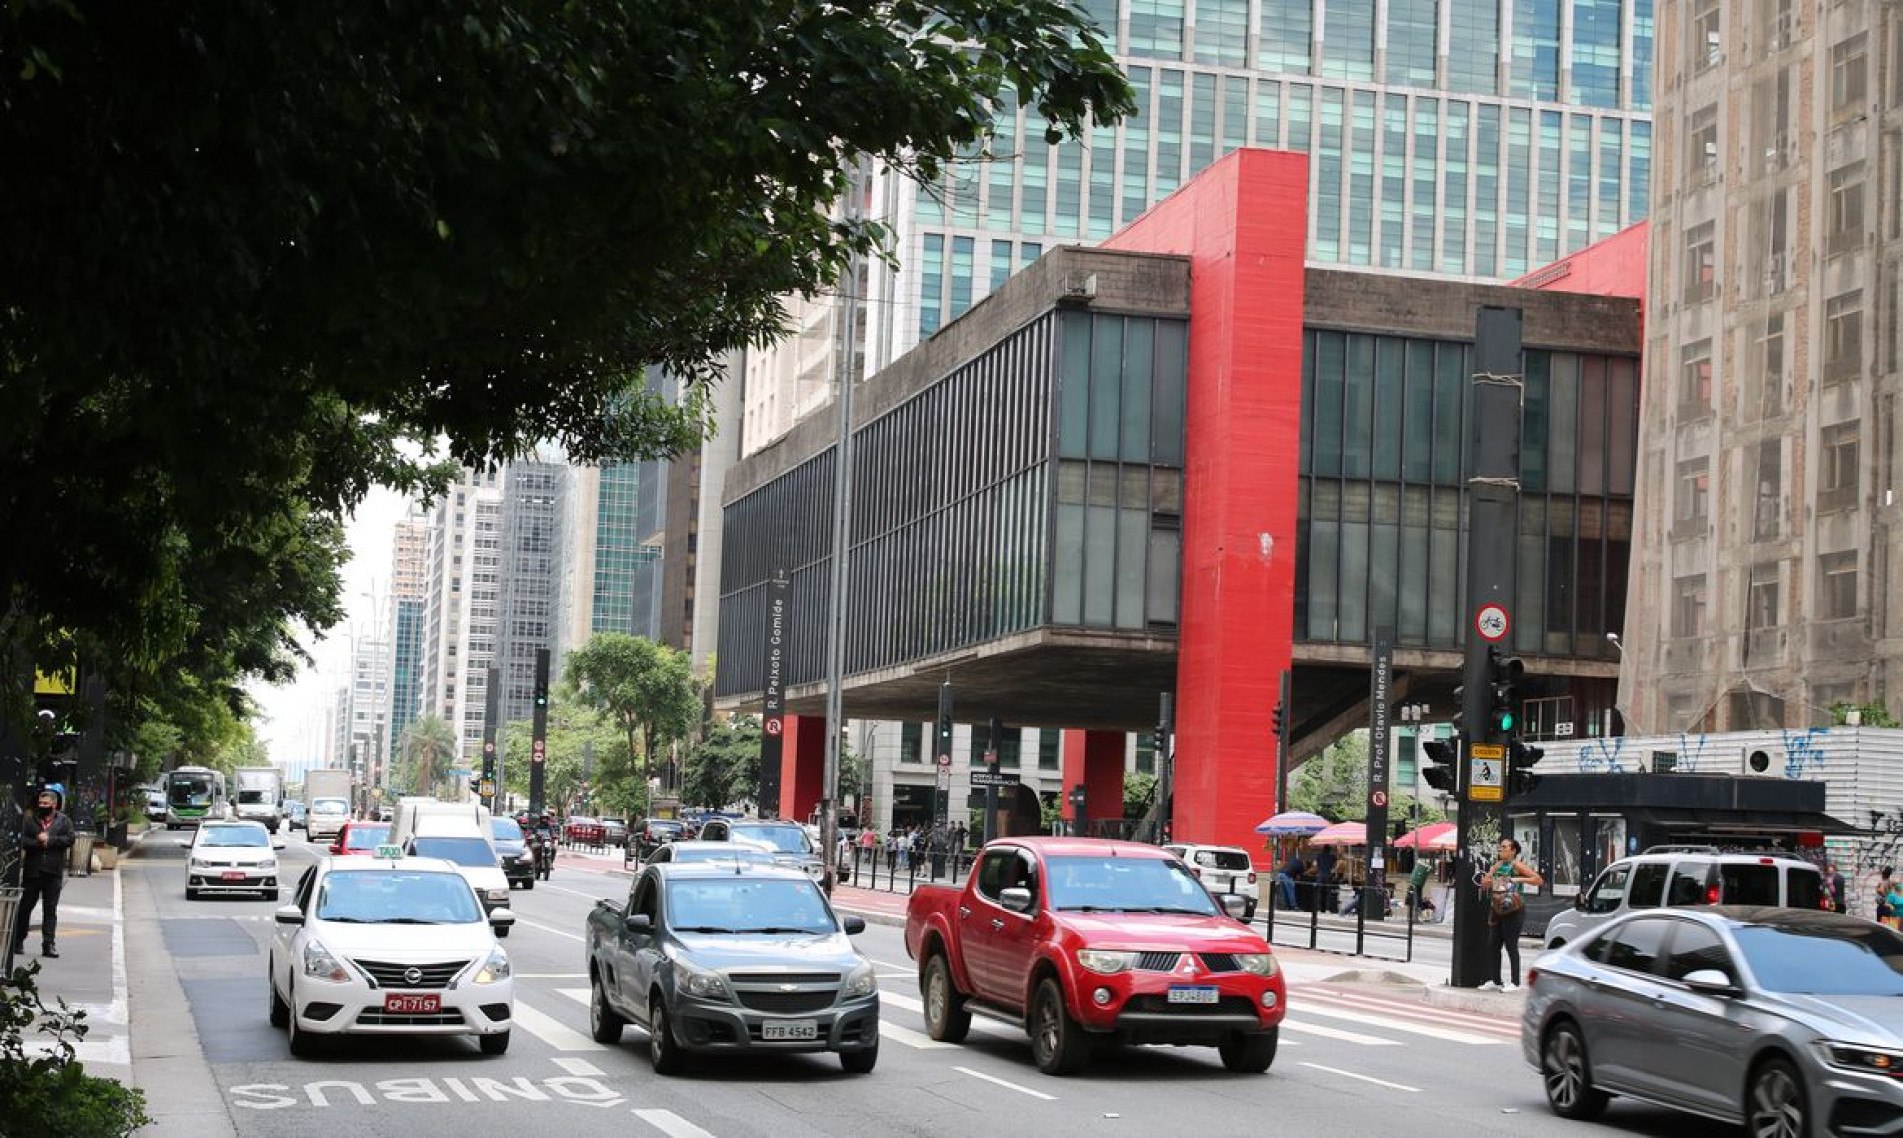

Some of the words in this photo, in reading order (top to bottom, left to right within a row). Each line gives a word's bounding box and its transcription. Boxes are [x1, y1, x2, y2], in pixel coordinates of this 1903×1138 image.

[770, 599, 783, 645] Gomide
[768, 649, 780, 695] Peixoto
[1376, 656, 1387, 701] Mendes
[767, 698, 778, 709] R.
[1373, 741, 1384, 770] Prof.
[1373, 772, 1382, 783] R.
[379, 846, 401, 856] TAXI
[765, 1026, 785, 1037] FFB
[788, 1026, 814, 1037] 4542
